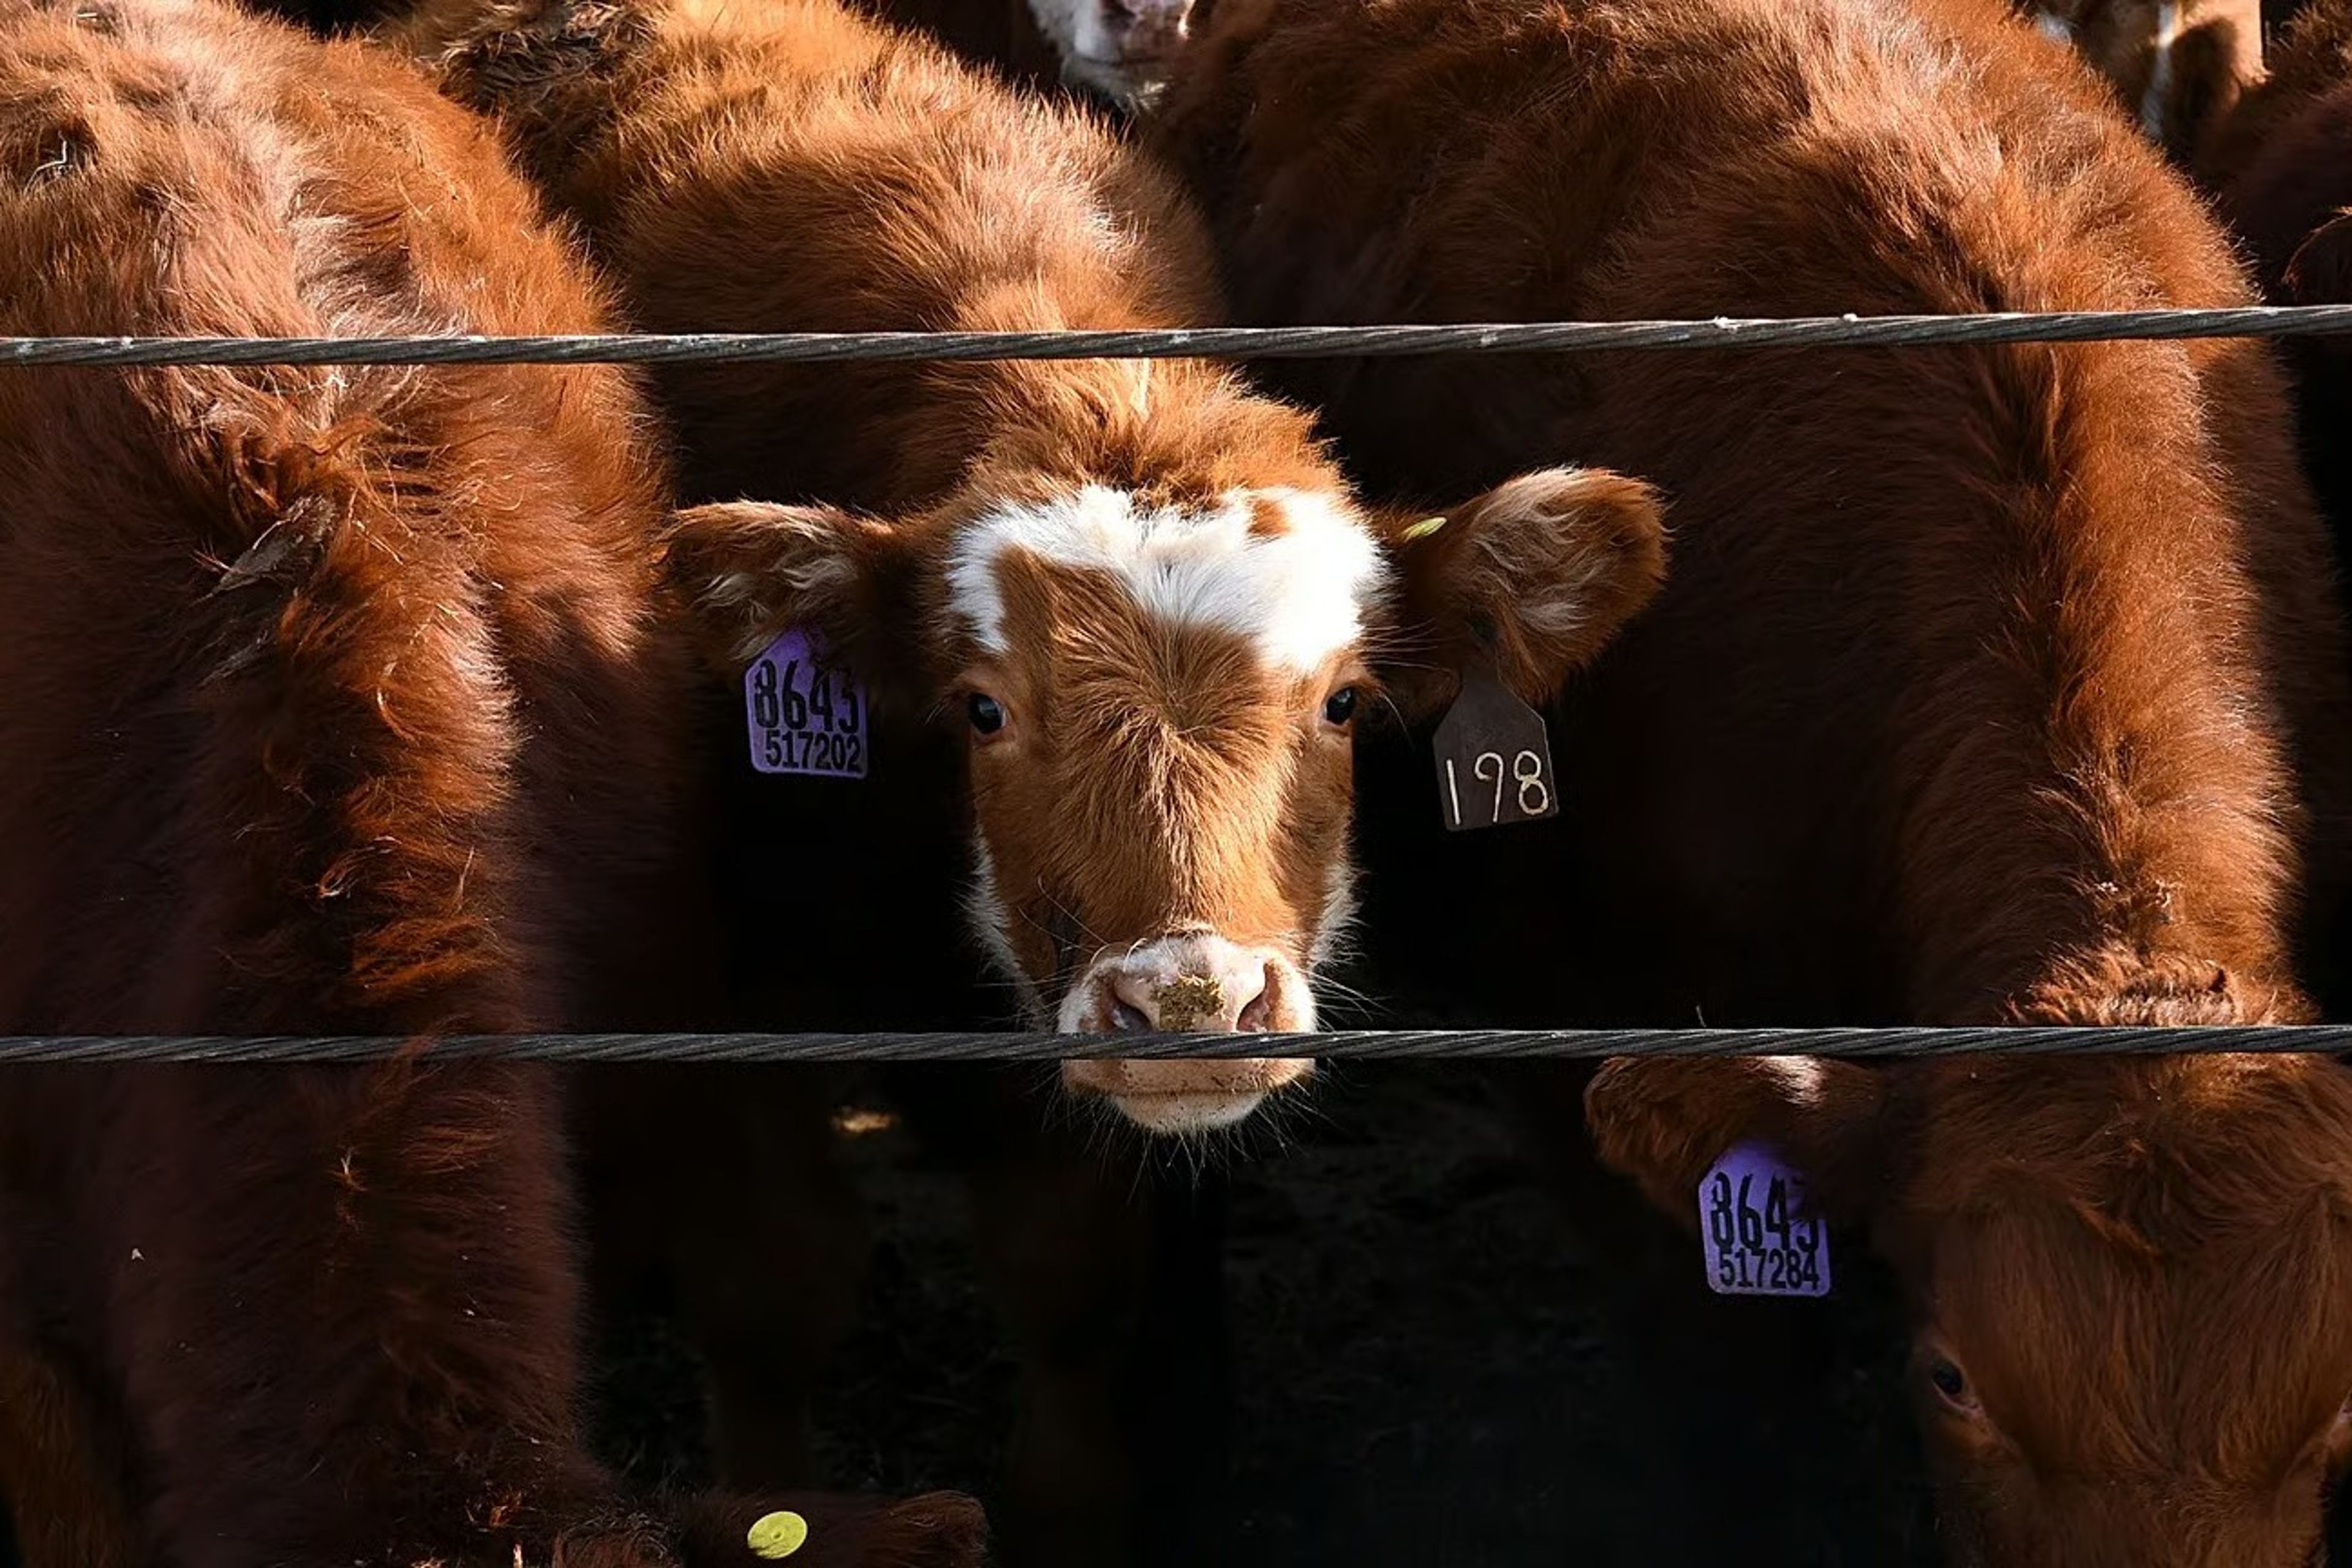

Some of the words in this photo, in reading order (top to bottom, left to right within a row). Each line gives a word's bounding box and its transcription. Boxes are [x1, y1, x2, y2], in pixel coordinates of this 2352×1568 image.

[764, 729, 864, 772] 517202
[1446, 750, 1549, 825] 198
[1719, 1248, 1820, 1291] 517284
